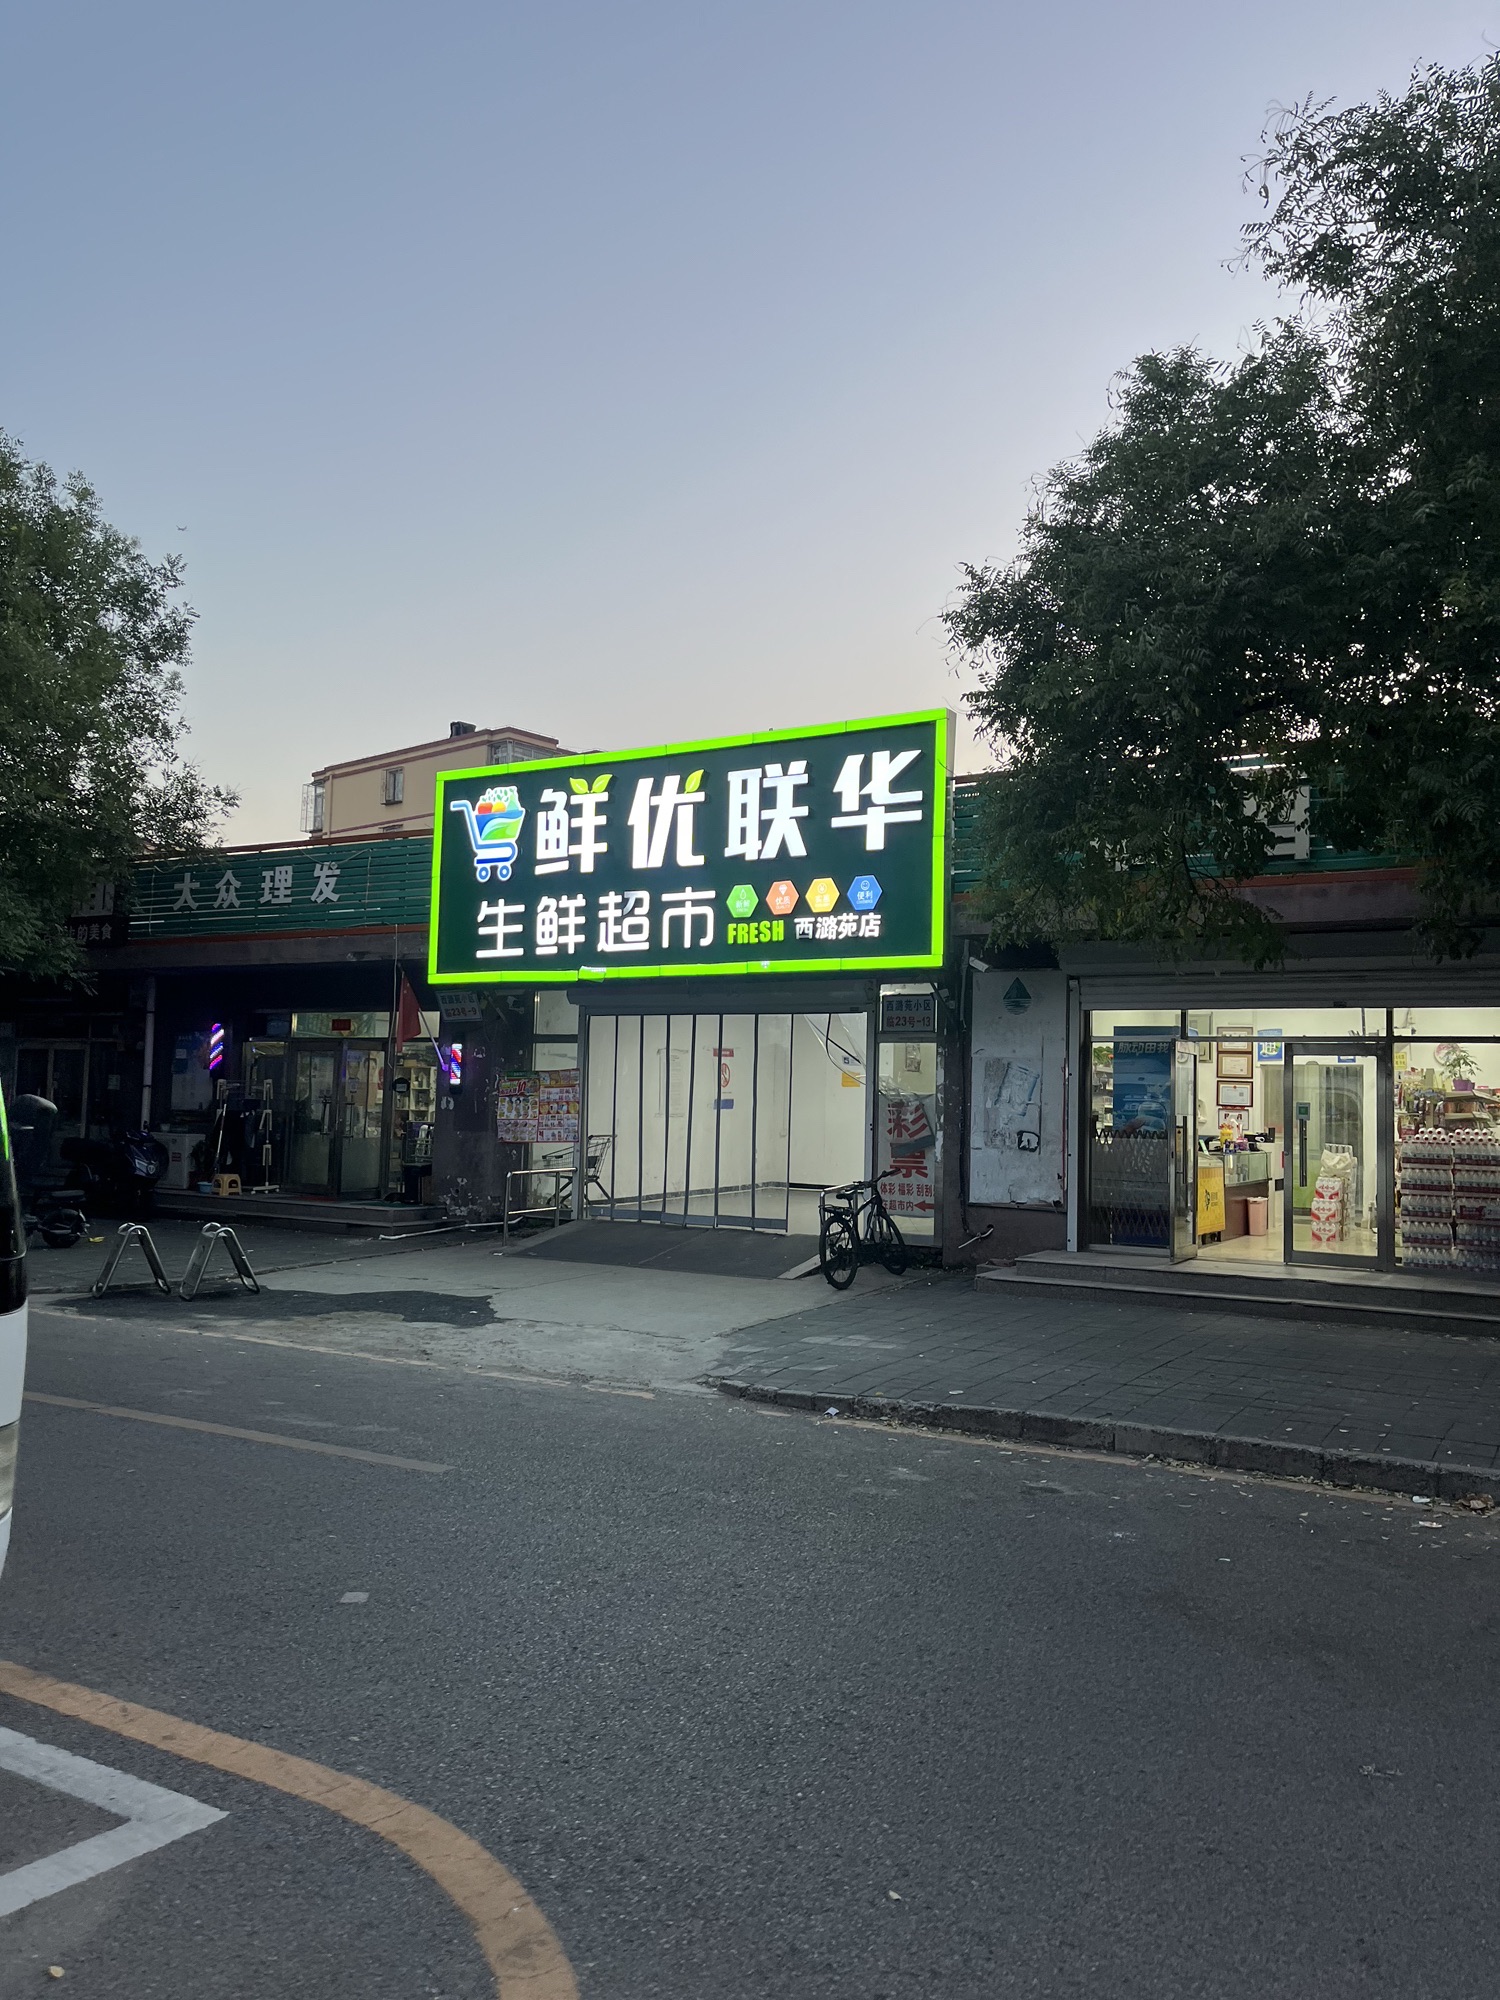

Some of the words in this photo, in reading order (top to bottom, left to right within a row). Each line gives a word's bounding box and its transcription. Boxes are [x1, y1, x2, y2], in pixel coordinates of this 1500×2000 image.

[534, 748, 924, 875] 鲜优联华
[172, 861, 341, 911] 大众理发
[475, 886, 717, 959] 生鲜超市
[727, 920, 785, 945] FRESH
[793, 912, 882, 941] 西潞苑店
[886, 998, 931, 1012] 西潞苑小区
[886, 1015, 931, 1028] 临23号-13
[880, 1182, 896, 1196] 体彩
[916, 1183, 935, 1199] 刮刮
